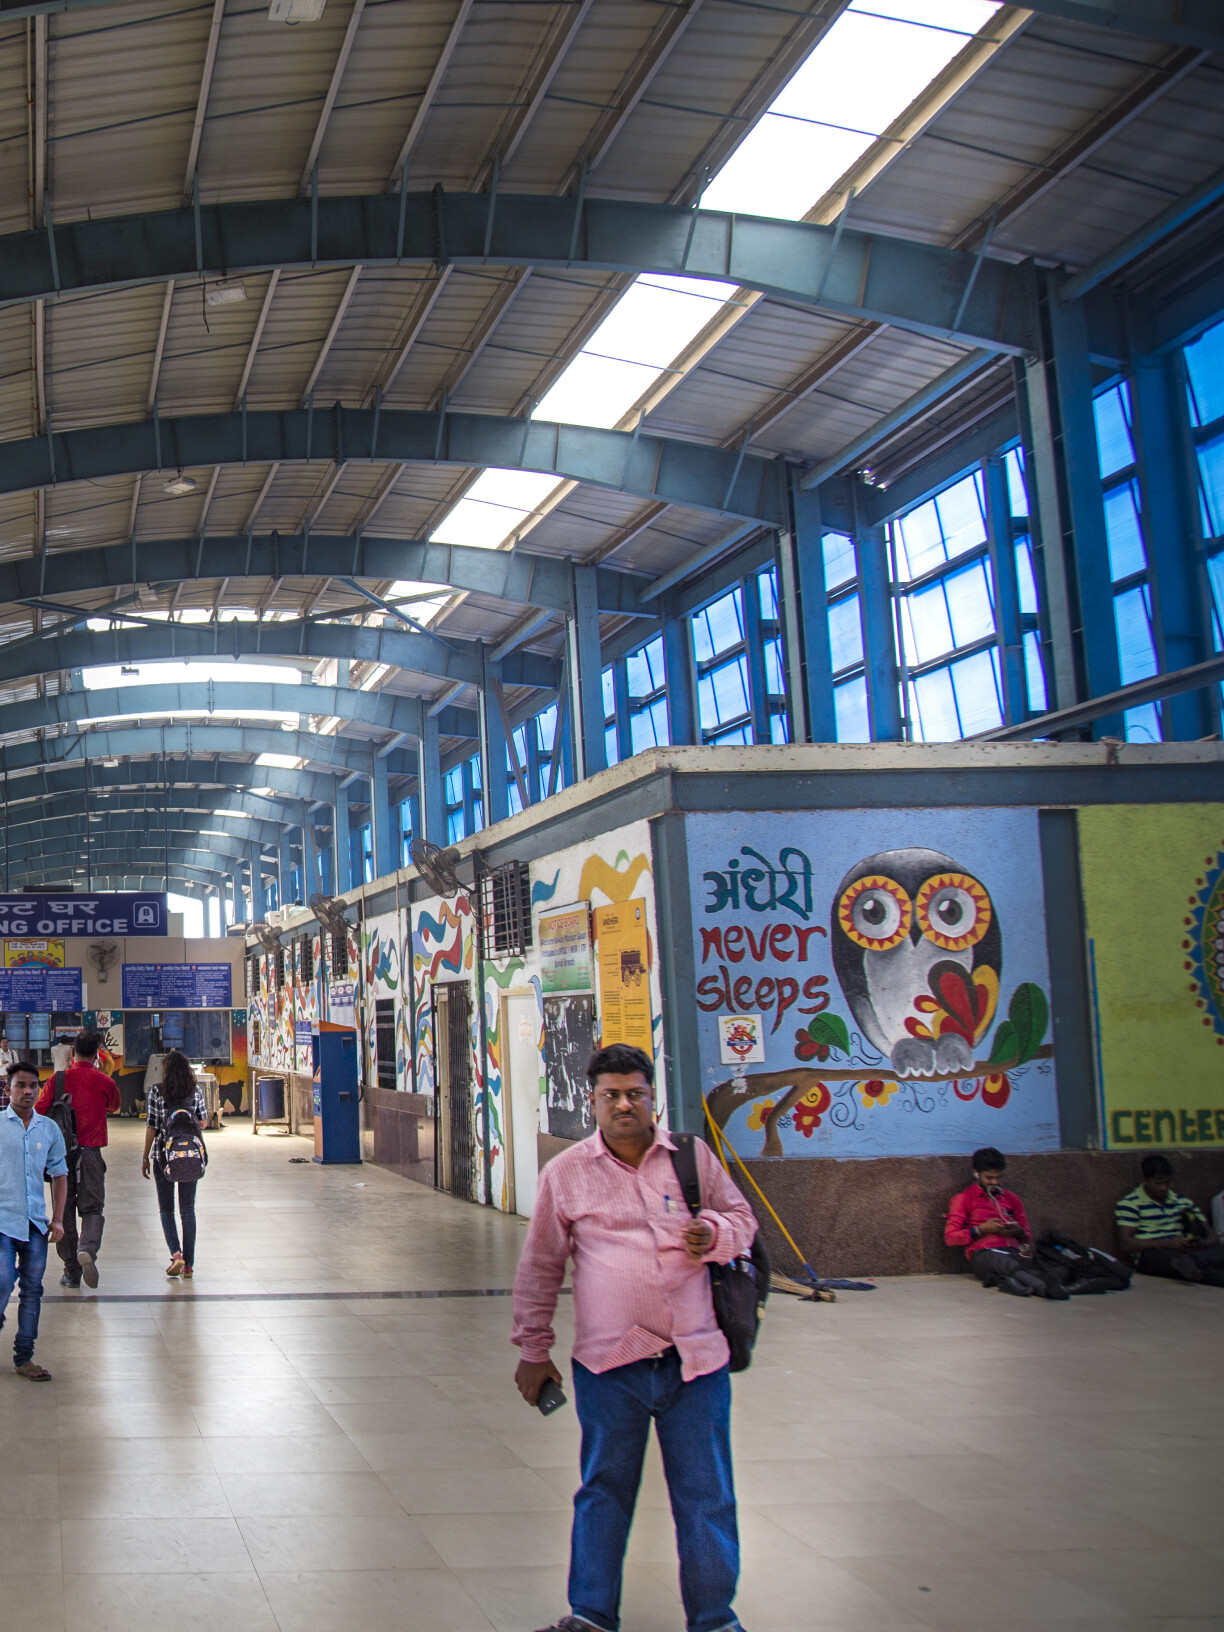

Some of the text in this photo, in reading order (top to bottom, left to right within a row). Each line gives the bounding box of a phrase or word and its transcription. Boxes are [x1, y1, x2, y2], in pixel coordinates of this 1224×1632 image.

[703, 846, 814, 921] अंधेरी
[47, 901, 99, 915] घर
[37, 918, 128, 934] OFFICE
[548, 915, 579, 931] NOTICE BOARD
[699, 923, 827, 964] never
[697, 965, 830, 1035] sleeps
